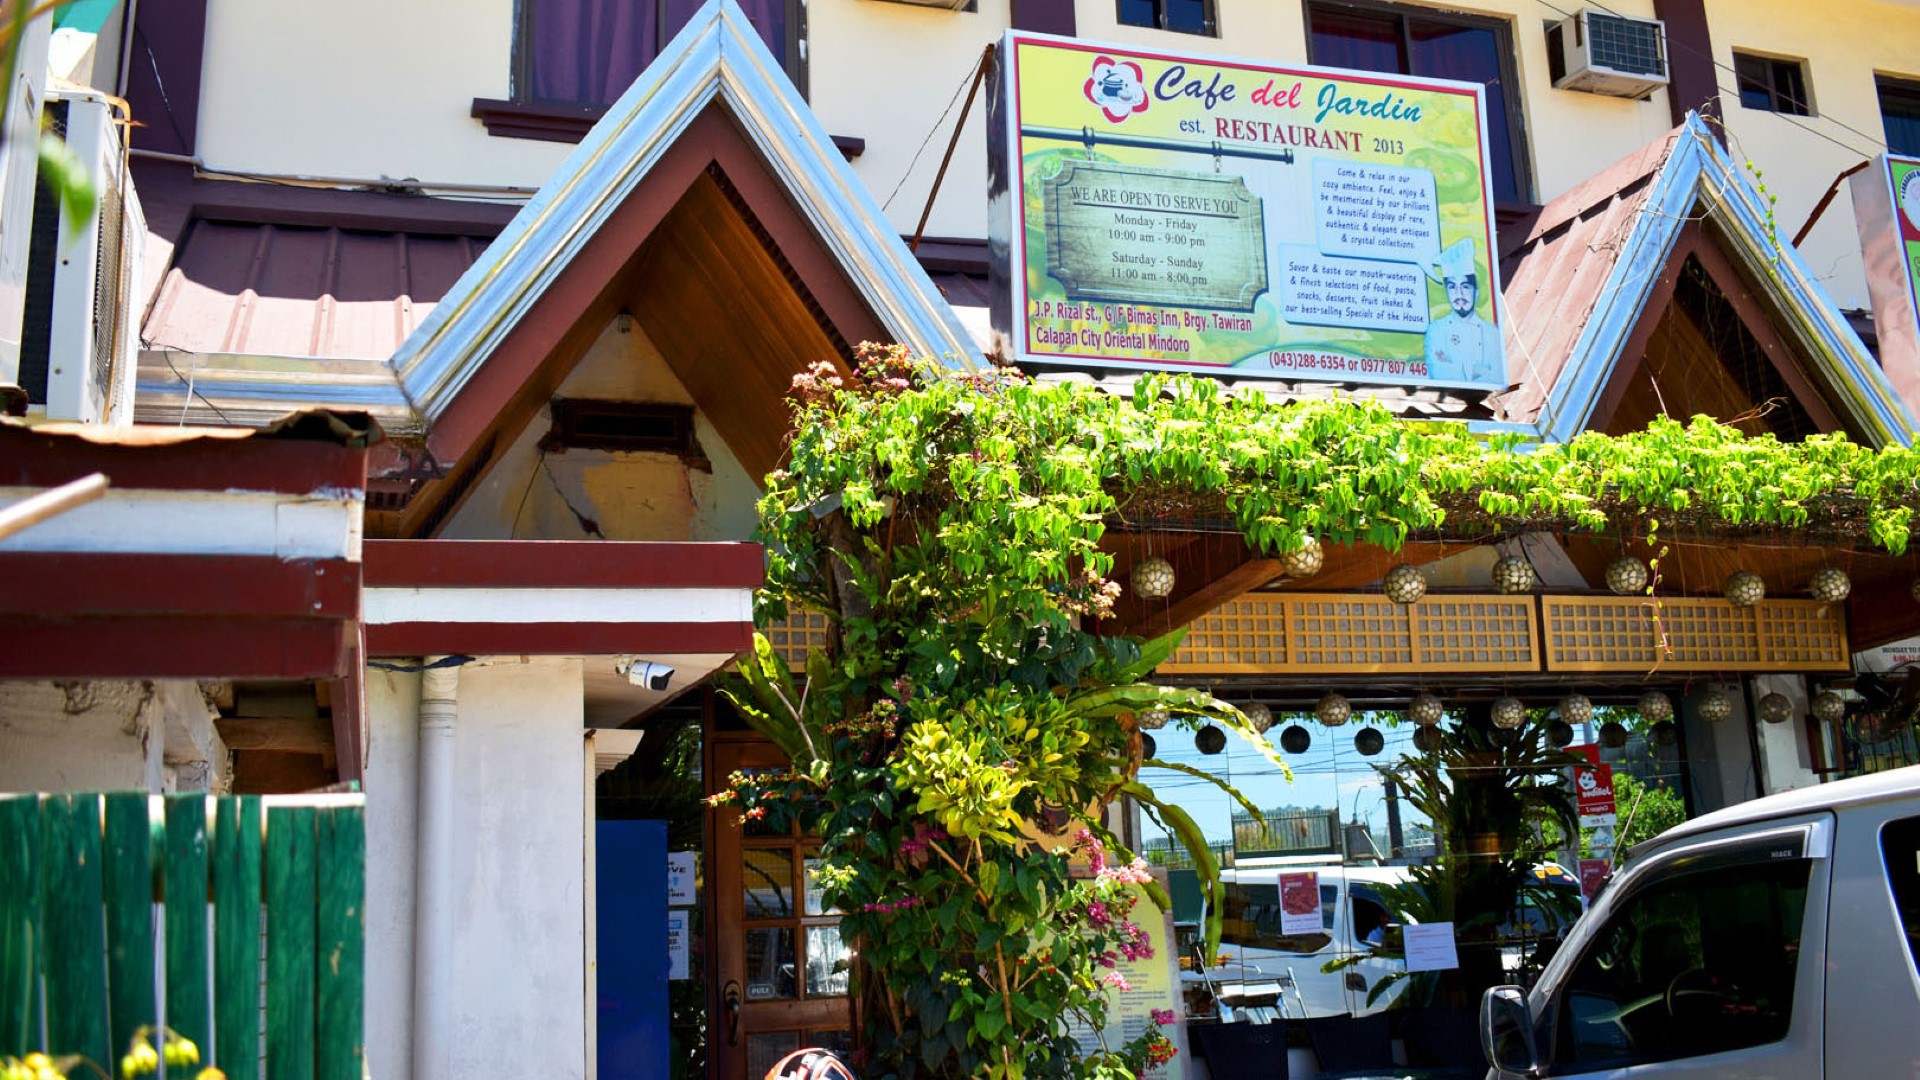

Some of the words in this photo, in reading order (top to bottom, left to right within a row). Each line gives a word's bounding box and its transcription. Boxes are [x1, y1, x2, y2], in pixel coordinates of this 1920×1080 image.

[1153, 65, 1236, 110] Cafe
[1250, 79, 1302, 109] del
[1314, 83, 1422, 123] Jardin
[1179, 119, 1205, 134] est.
[1215, 117, 1363, 153] RESTAURANT
[1372, 137, 1404, 155] 2013
[1338, 168, 1356, 178] Come
[1359, 170, 1364, 178] &
[1369, 171, 1385, 180] relax
[1323, 181, 1338, 190] cozy
[1399, 187, 1417, 199] enjoy
[1420, 189, 1425, 197] &
[1071, 187, 1089, 200] WE
[1093, 190, 1116, 203] ARE
[1120, 191, 1151, 205] OPEN
[1154, 194, 1171, 208] TO
[1174, 195, 1211, 211] SERVE
[1213, 199, 1238, 214] YOU
[1321, 192, 1328, 200] be
[1333, 195, 1373, 205] mesmerized
[1377, 197, 1384, 209] by
[1404, 200, 1430, 211] brilliant
[1115, 214, 1155, 229] Monday
[1166, 219, 1197, 233] Friday
[1327, 205, 1333, 214] &
[1337, 206, 1369, 218] beautiful
[1372, 210, 1395, 223] display
[1398, 213, 1407, 221] of
[1325, 219, 1359, 230] authentic
[1363, 222, 1368, 231] &
[1372, 224, 1397, 235] elegant
[1401, 229, 1429, 238] antiques
[1109, 229, 1136, 241] 10:00
[1165, 233, 1187, 245] 9:00
[1190, 238, 1205, 248] pm
[1341, 234, 1347, 242] &
[1351, 236, 1375, 246] crystal
[1112, 251, 1156, 267] Saturday
[1167, 256, 1203, 270] Sunday
[1111, 267, 1138, 279] 11:00
[1141, 273, 1156, 281] am
[1192, 276, 1207, 286] pm
[1289, 262, 1309, 272] Savor
[1312, 264, 1318, 273] &
[1322, 266, 1341, 275] taste
[1360, 270, 1417, 284] mouth-watering
[1290, 276, 1296, 285] &
[1301, 277, 1320, 287] finest
[1325, 280, 1359, 290] selections
[1363, 283, 1371, 291] of
[1361, 296, 1378, 305] fruit
[1382, 299, 1403, 308] shakes
[1407, 299, 1413, 308] &
[1035, 301, 1054, 318] J.P.
[1057, 303, 1082, 320] Rizal
[1085, 305, 1102, 324] st.,
[1105, 306, 1123, 324] G/F
[1127, 307, 1158, 326] Bimas
[1160, 310, 1181, 329] Inn,
[1184, 311, 1210, 332] Brgy.
[1212, 313, 1252, 331] Tawiran
[1301, 304, 1342, 317] best-selling
[1346, 307, 1373, 319] Specials
[1377, 311, 1385, 319] of
[1388, 311, 1399, 321] the
[1036, 327, 1078, 347] Calapan
[1081, 329, 1101, 349] City
[1104, 331, 1145, 349] Oriental
[1149, 335, 1190, 352] Mindoro
[1269, 352, 1345, 371] (043)288-6354
[1350, 360, 1358, 371] or
[1361, 359, 1385, 372] 0977
[1389, 360, 1406, 374] 807
